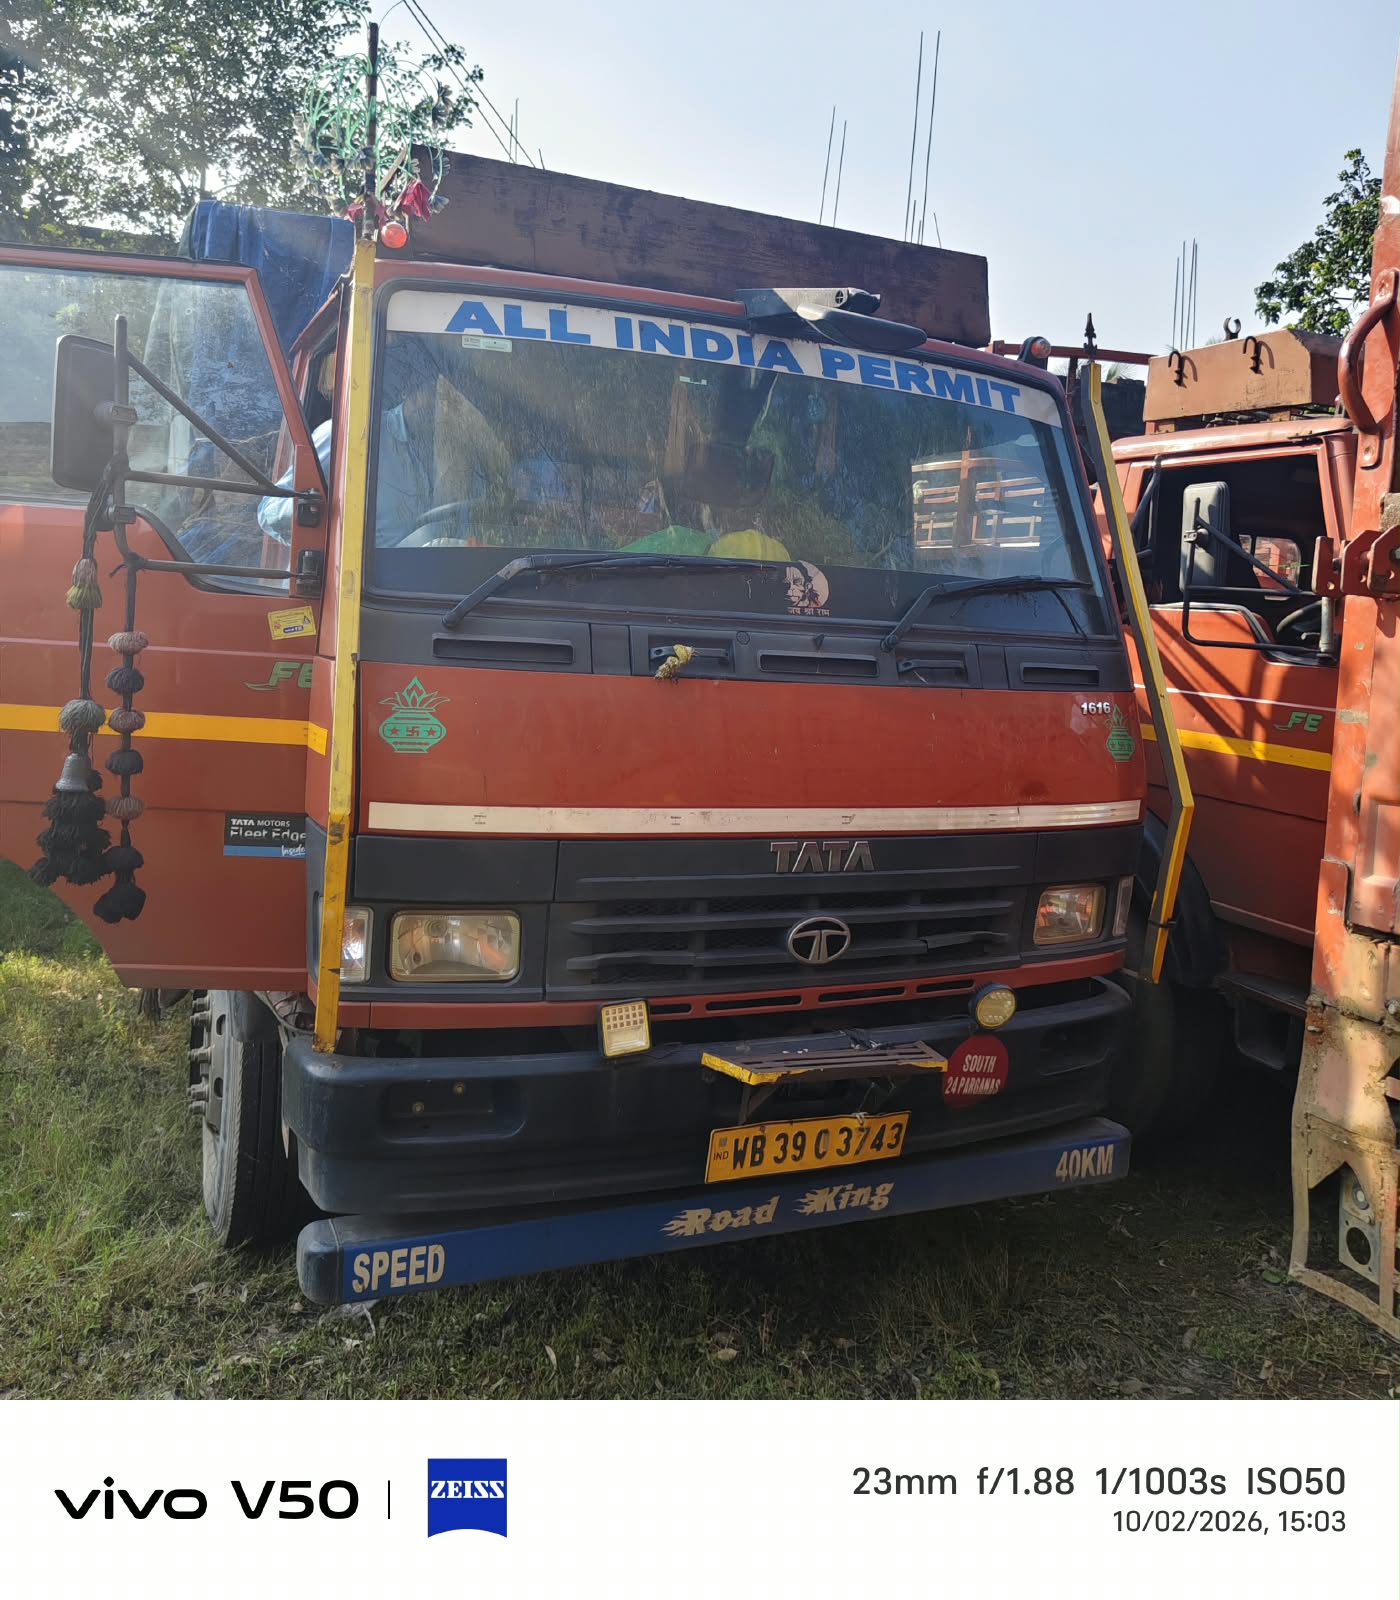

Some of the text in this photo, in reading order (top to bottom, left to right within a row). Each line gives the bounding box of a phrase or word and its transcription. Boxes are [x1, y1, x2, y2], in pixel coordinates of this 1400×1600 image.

[445, 301, 1021, 413] ALL INDIA PERMIT
[1081, 701, 1111, 715] 1616
[1286, 711, 1324, 732] FE
[230, 818, 255, 826] TATA
[230, 826, 307, 842] Fleet Edge
[770, 841, 875, 873] TATA
[962, 1054, 997, 1073] SOUTH
[945, 1076, 1001, 1095] 24 PARGANAS
[713, 1150, 729, 1161] IND
[732, 1134, 767, 1170] WB
[773, 1130, 806, 1164] 39
[836, 1122, 904, 1158] 3743
[1055, 1143, 1115, 1183] 40KM
[662, 1182, 895, 1238] Road King
[351, 1243, 446, 1294] SPEED
